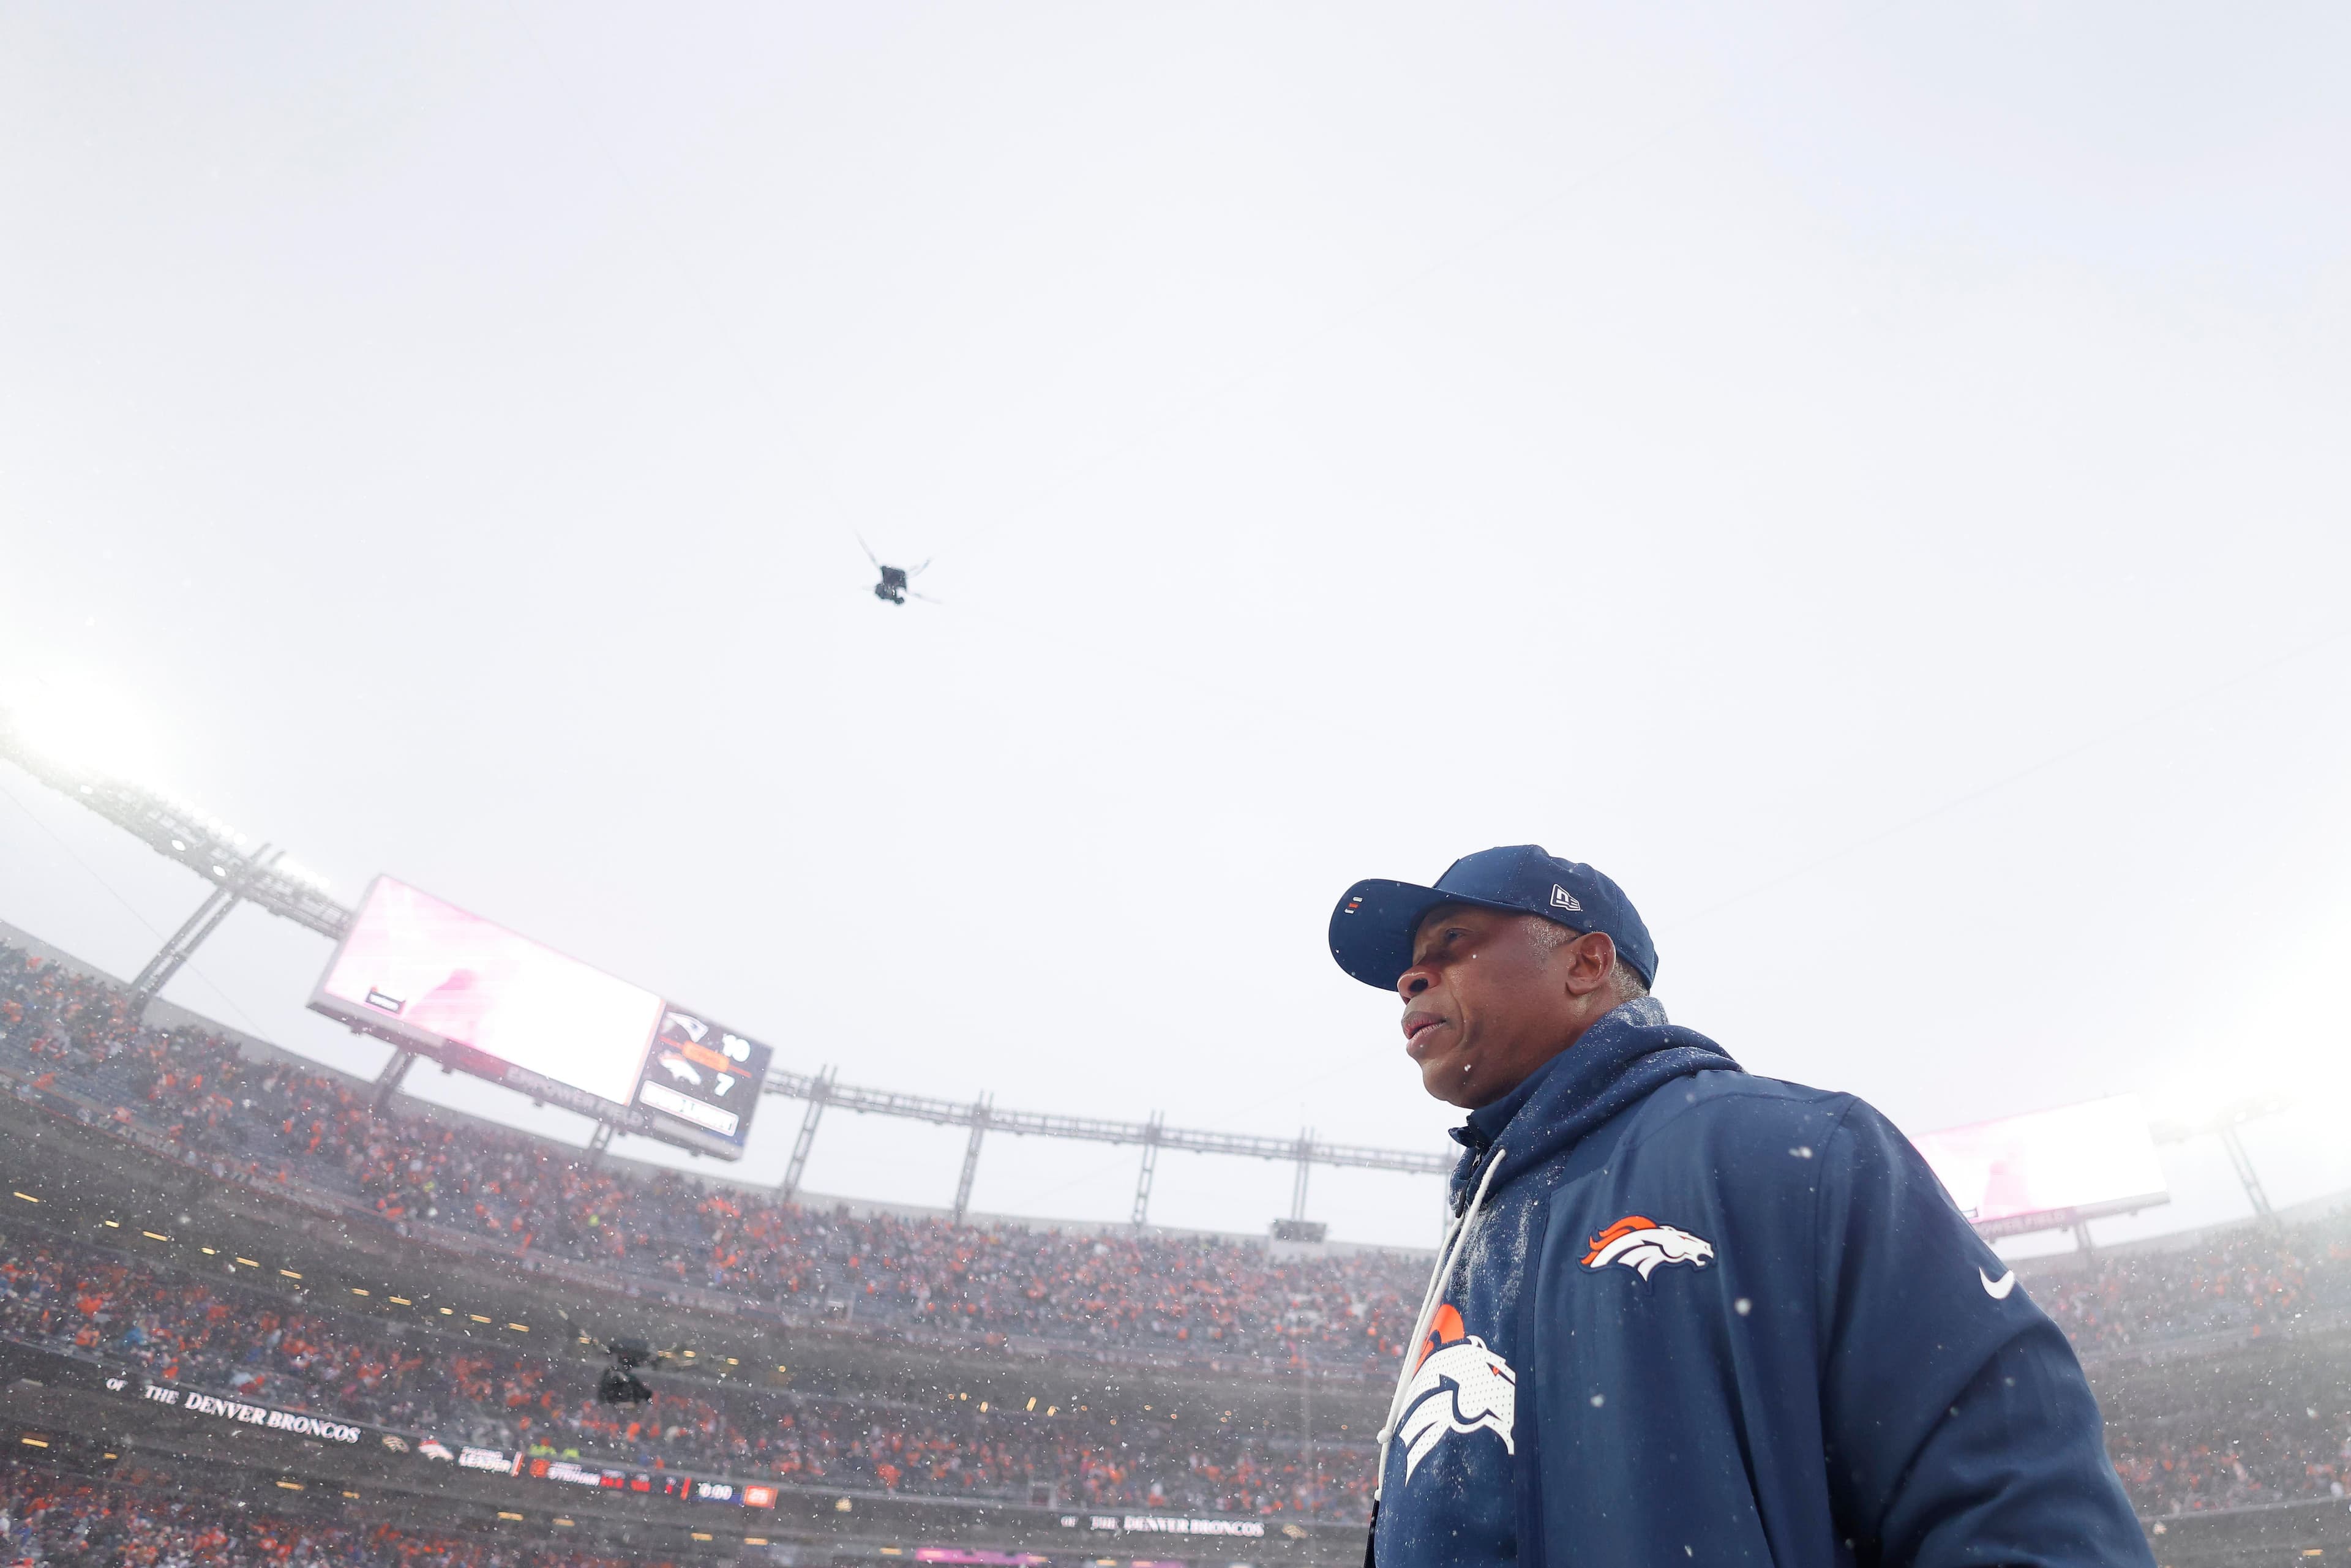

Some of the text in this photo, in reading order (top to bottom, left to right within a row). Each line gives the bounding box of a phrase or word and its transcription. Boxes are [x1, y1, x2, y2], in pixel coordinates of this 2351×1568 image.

[714, 1073, 735, 1097] 7
[146, 1384, 180, 1405] THE
[185, 1392, 267, 1425] DENVER
[266, 1410, 361, 1444] BRONCOS
[1124, 1516, 1189, 1533] DENVER
[1190, 1519, 1264, 1537] BRONCOS
